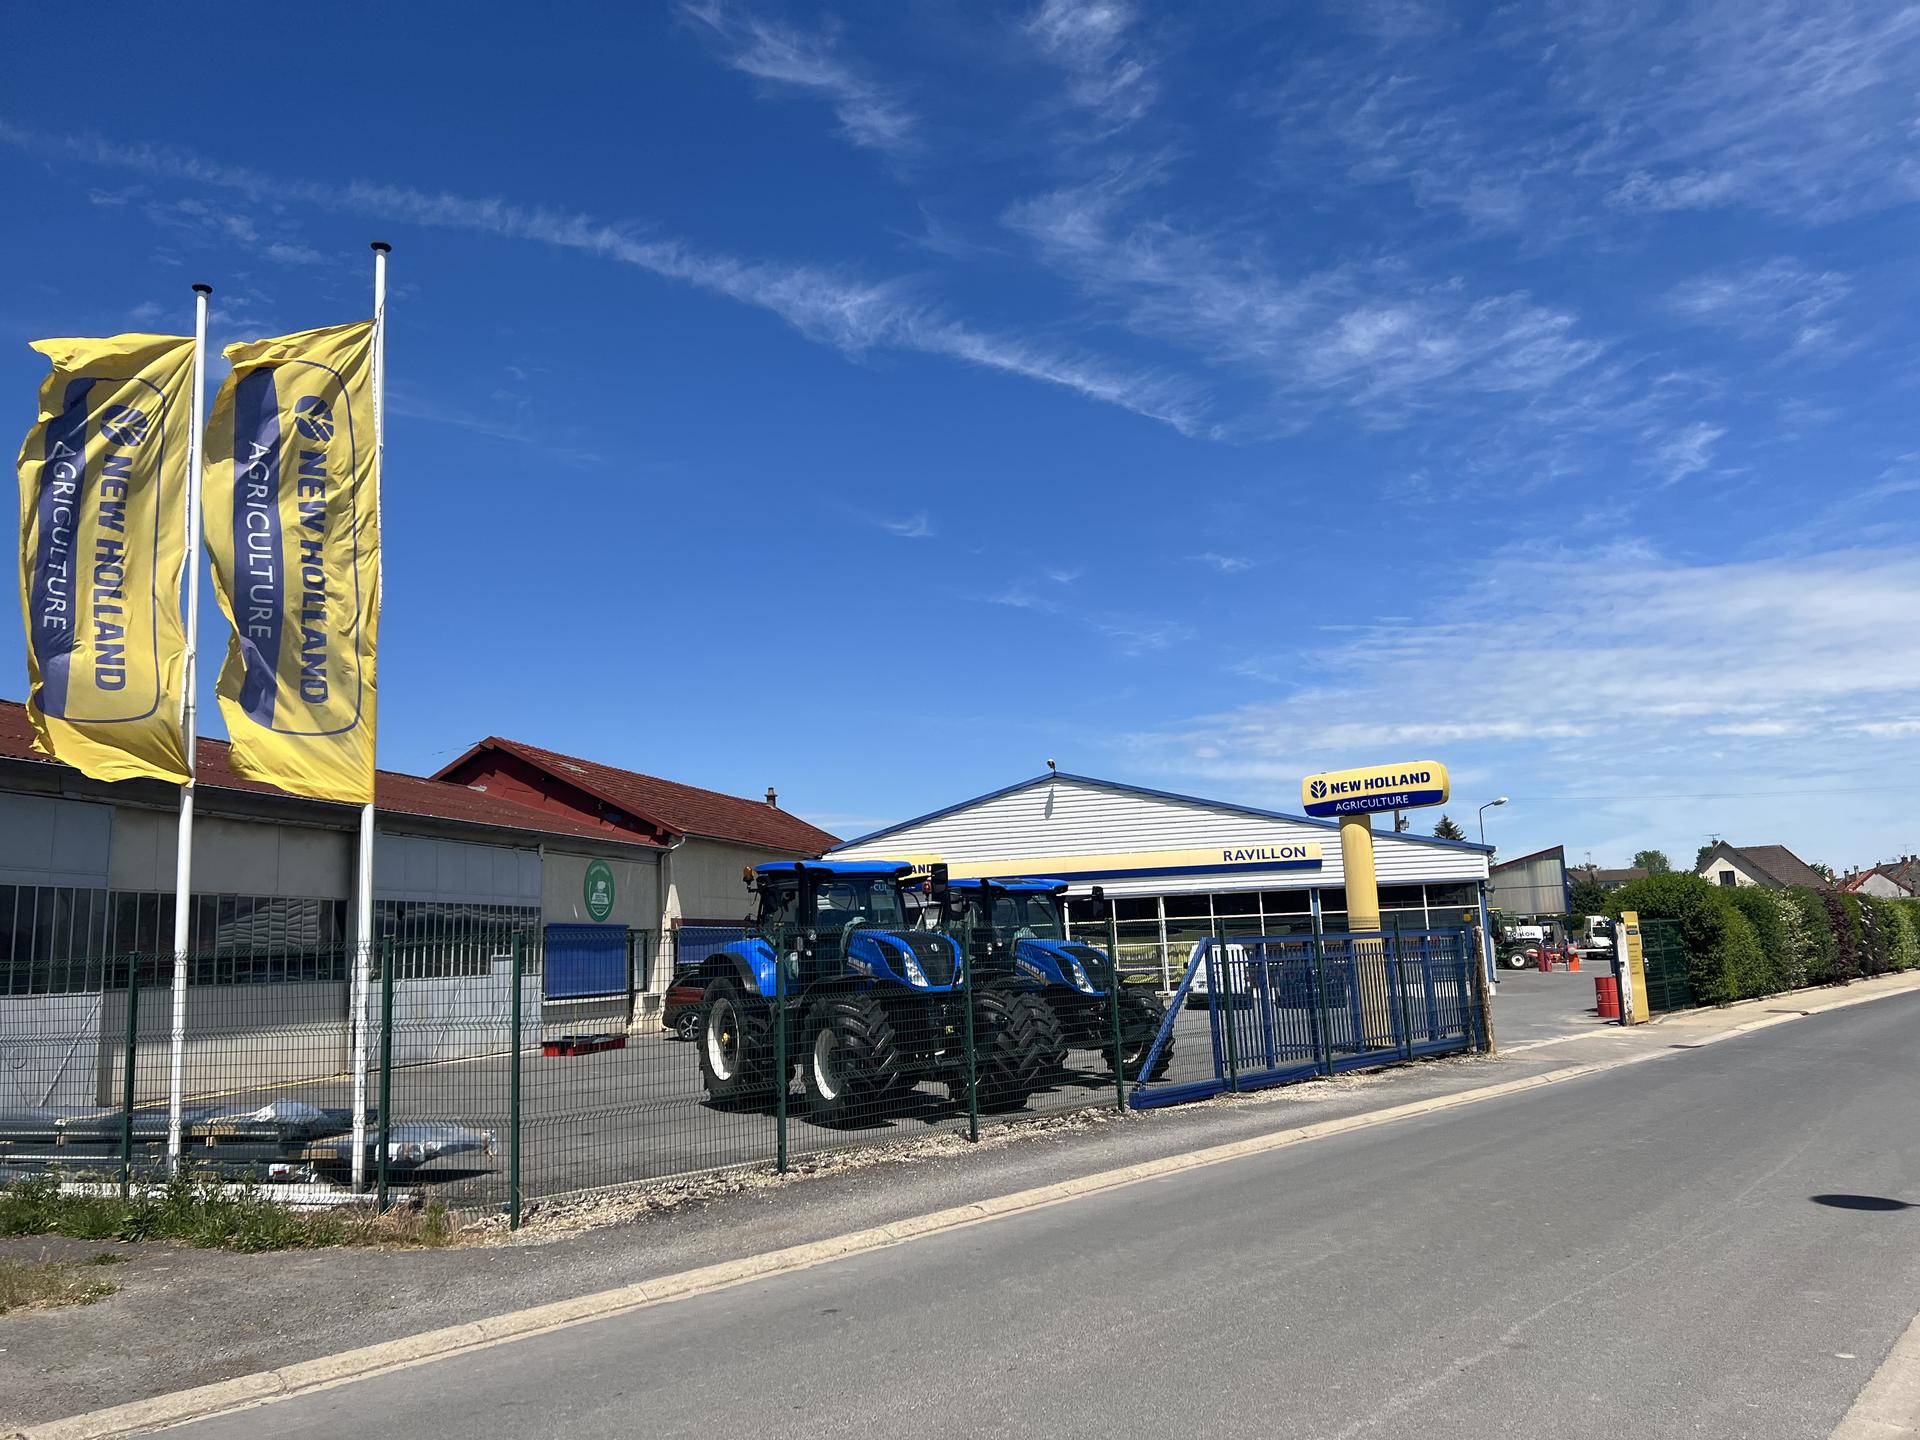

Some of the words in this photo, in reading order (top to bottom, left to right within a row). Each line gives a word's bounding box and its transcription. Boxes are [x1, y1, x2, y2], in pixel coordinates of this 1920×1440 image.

[98, 453, 133, 534] NEW
[297, 452, 328, 533] NEW
[43, 440, 78, 631] AGRICULTURE
[246, 440, 274, 640] AGRICULTURE
[93, 538, 128, 691] HOLLAND
[300, 539, 329, 704] HOLLAND
[1330, 780, 1361, 794] NEW
[1364, 771, 1431, 790] HOLLAND
[1335, 794, 1409, 812] AGRICULTURE
[1223, 846, 1307, 862] RAVILLON
